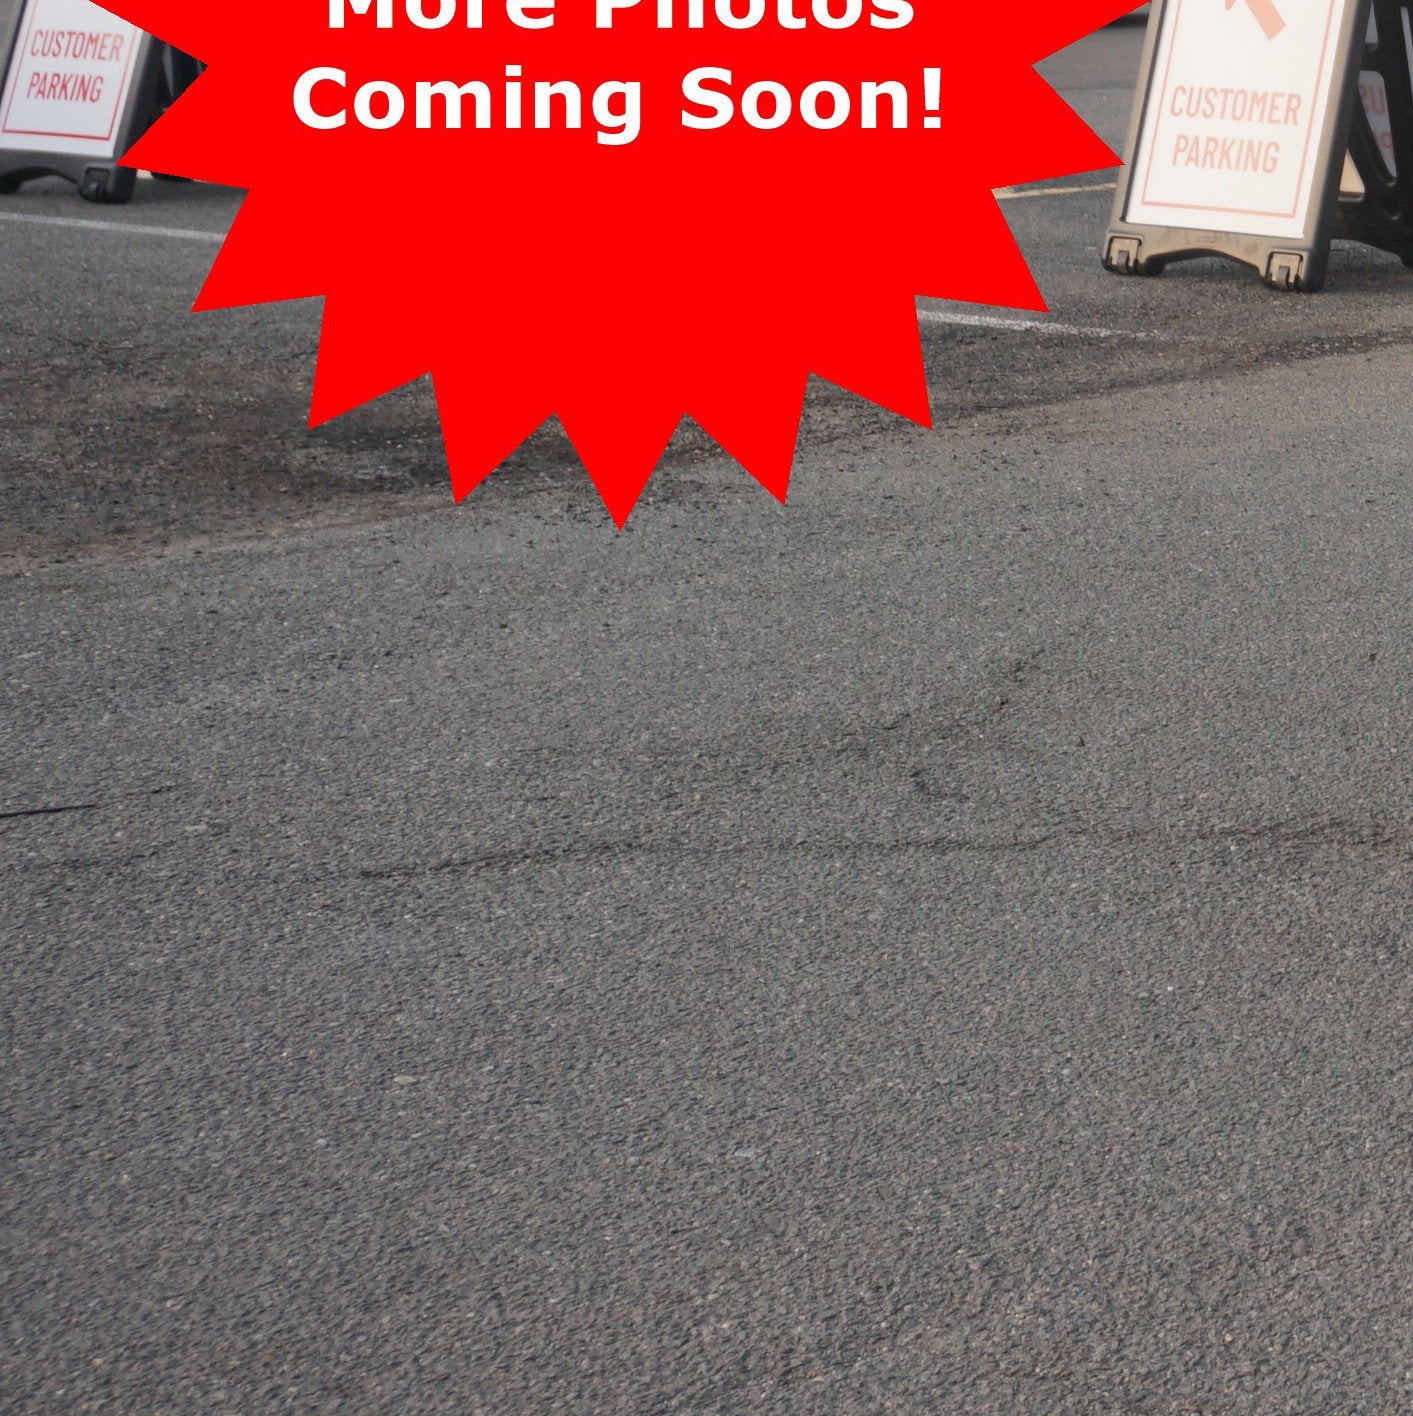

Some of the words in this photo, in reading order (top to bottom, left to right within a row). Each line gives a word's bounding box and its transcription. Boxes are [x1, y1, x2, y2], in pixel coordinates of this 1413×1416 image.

[30, 29, 125, 62] CUSTOMER
[26, 71, 104, 103] PARKING
[1169, 85, 1302, 126] CUSTOMER
[1171, 134, 1280, 174] PARKING
